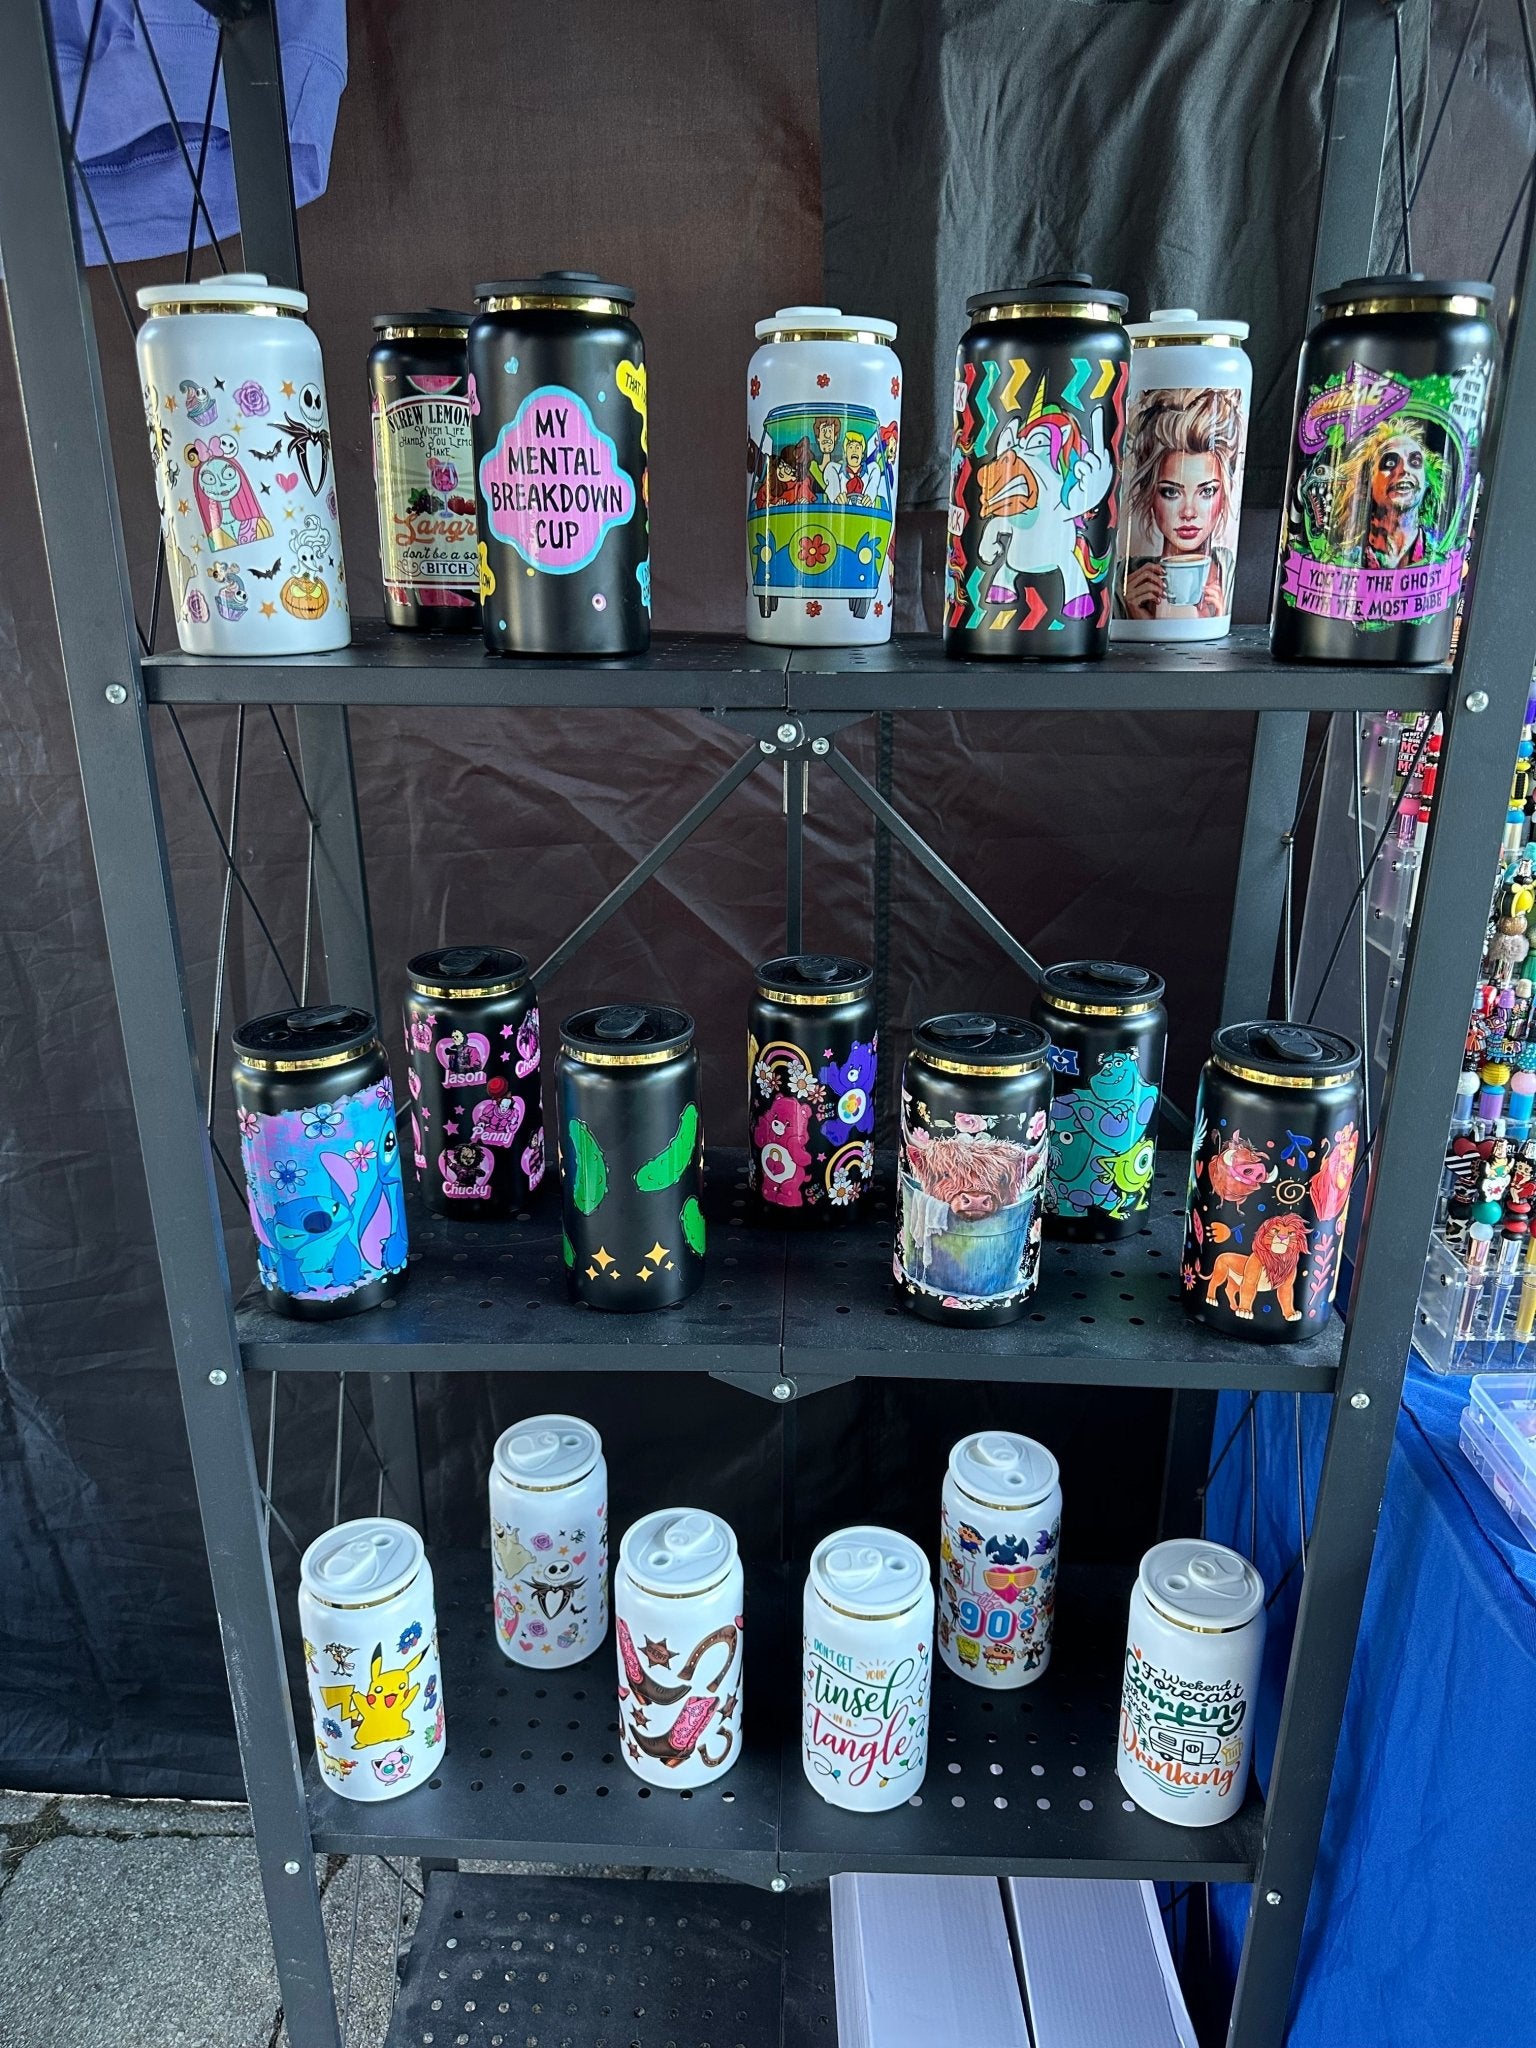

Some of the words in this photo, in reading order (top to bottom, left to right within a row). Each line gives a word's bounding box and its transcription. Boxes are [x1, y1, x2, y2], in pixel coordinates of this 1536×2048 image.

[387, 405, 423, 434] SCREW
[428, 404, 471, 427] LEMON
[445, 425, 465, 437] LIFE
[535, 408, 568, 438] MY
[428, 435, 446, 448] YOU
[508, 446, 601, 476] MENTAL
[491, 482, 622, 513] BREAKDOWN
[536, 520, 579, 549] CUP
[403, 546, 430, 559] don't
[432, 547, 447, 560] be
[450, 551, 461, 560] a
[426, 563, 468, 574] BITCH
[1309, 569, 1359, 587] YOU'RE
[1366, 575, 1394, 593] THE
[1400, 570, 1441, 591] GHOST
[1302, 590, 1330, 612] WITH
[1336, 597, 1363, 617] THE
[1367, 599, 1408, 617] MOST
[1414, 593, 1442, 613] BABE
[1398, 760, 1425, 774] MM
[443, 1070, 484, 1085] Jason
[472, 1125, 513, 1144] Penny
[442, 1182, 489, 1196] Chucky
[814, 1638, 834, 1661] DON'T
[836, 1653, 853, 1672] GET
[866, 1669, 887, 1680] YOUR
[1141, 1661, 1244, 1703] Forecast
[1161, 1668, 1232, 1692] Weekend
[811, 1658, 914, 1719] tinsel
[1126, 1647, 1247, 1737] Camping
[807, 1704, 913, 1787] tangle
[1120, 1707, 1240, 1797] Drinking
